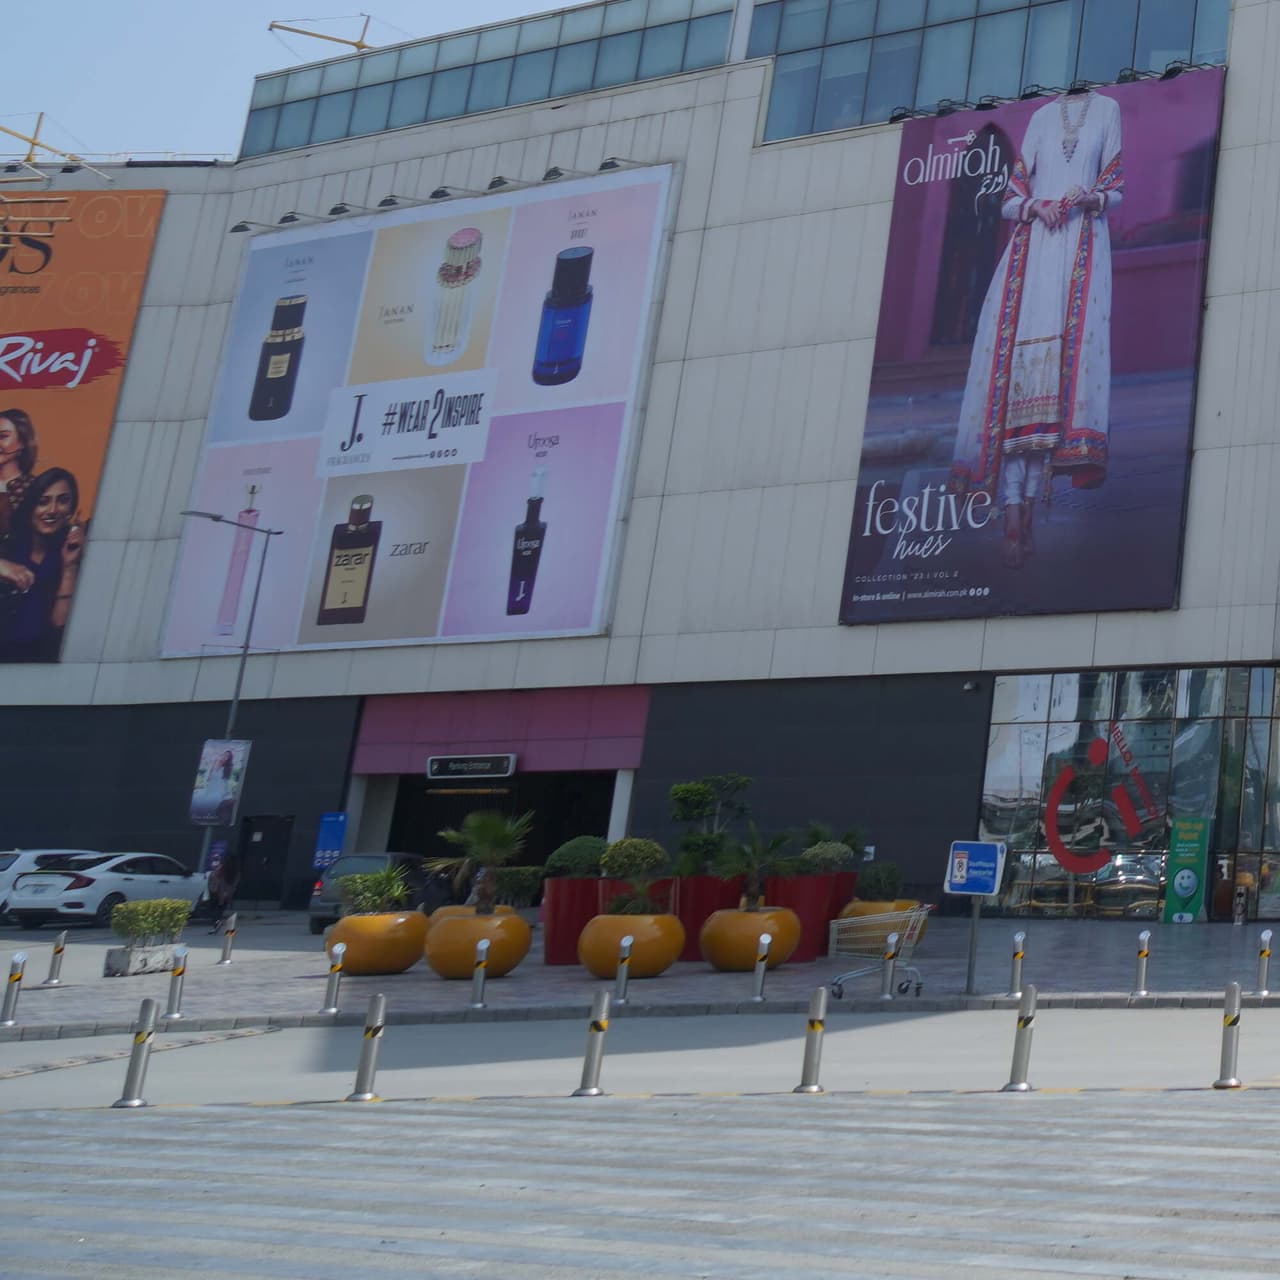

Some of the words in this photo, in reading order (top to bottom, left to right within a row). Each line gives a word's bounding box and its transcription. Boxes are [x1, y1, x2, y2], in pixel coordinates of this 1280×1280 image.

[904, 134, 1000, 186] almirah
[862, 479, 992, 537] festive
[390, 540, 431, 558] zarar
[892, 516, 953, 560] hues
[334, 551, 369, 567] zarar
[855, 573, 907, 583] COLLECTION
[933, 570, 949, 579] VOL
